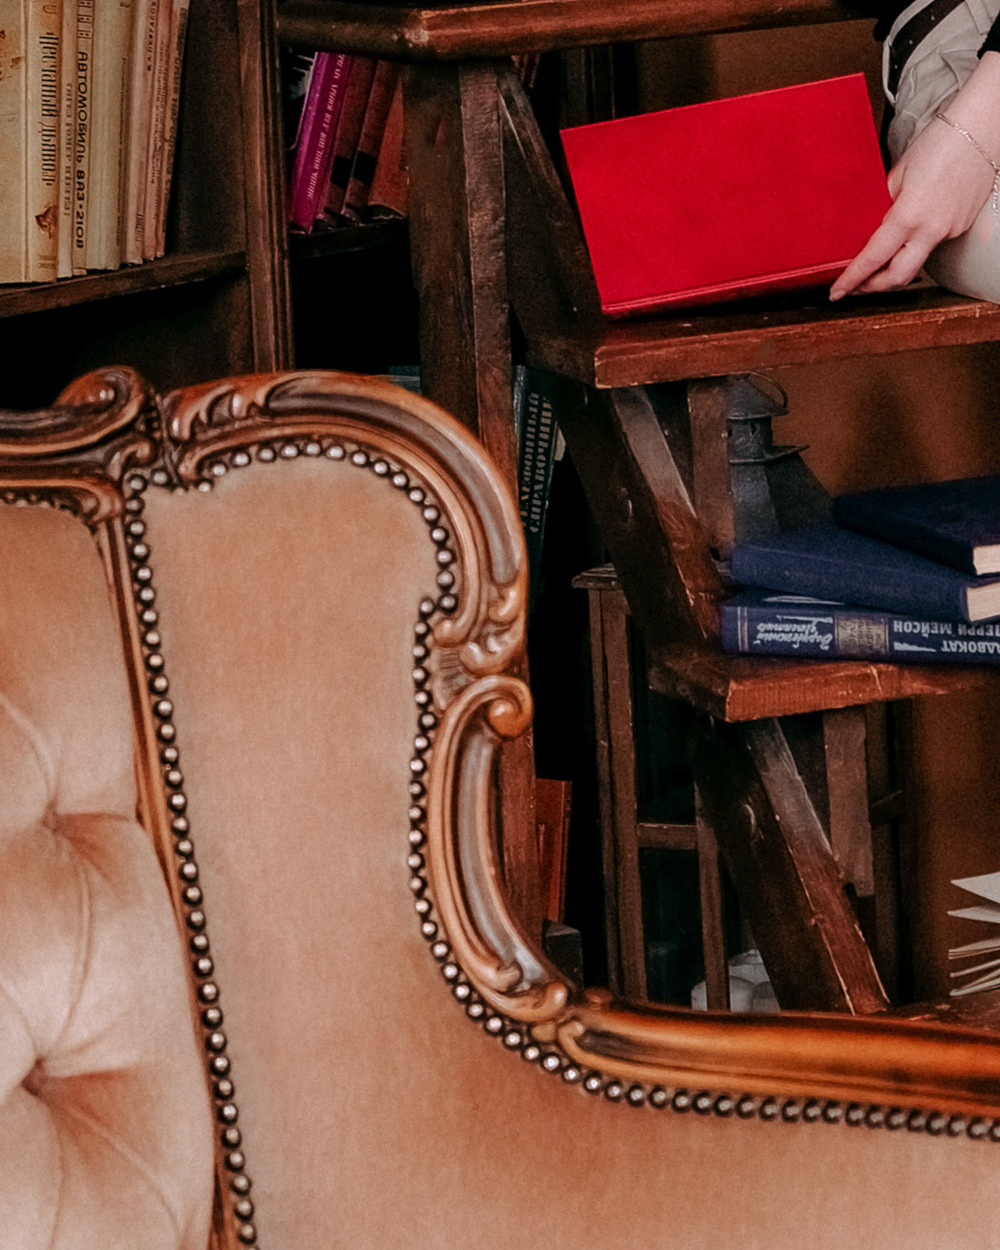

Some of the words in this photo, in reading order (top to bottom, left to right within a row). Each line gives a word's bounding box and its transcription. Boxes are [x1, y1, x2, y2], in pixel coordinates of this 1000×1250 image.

[75, 51, 87, 163] АВТОМОБИЛЬ
[528, 396, 553, 533] СПРАВОЧНИК
[892, 620, 951, 635] МЕЙСОН
